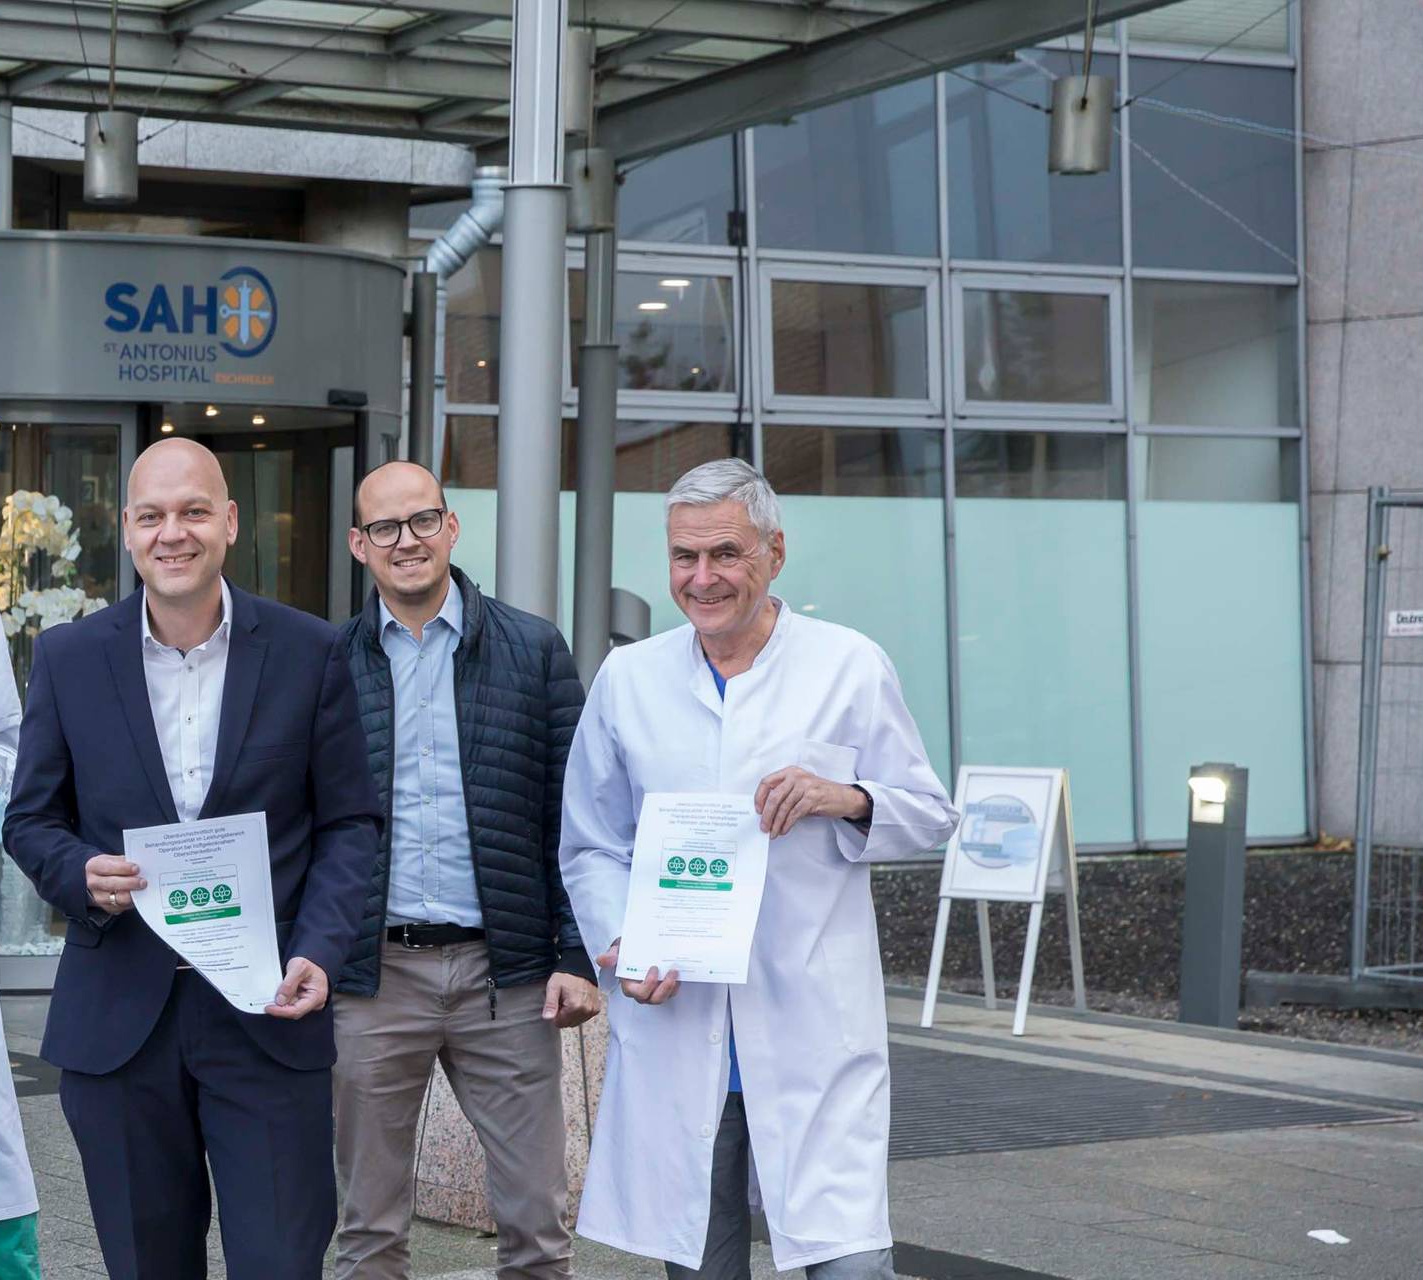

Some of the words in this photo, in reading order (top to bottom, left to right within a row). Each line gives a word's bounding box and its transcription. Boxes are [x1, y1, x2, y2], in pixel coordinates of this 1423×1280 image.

[104, 282, 218, 335] SAH
[119, 344, 217, 362] ANTONIUS
[119, 364, 210, 383] HOSPITAL
